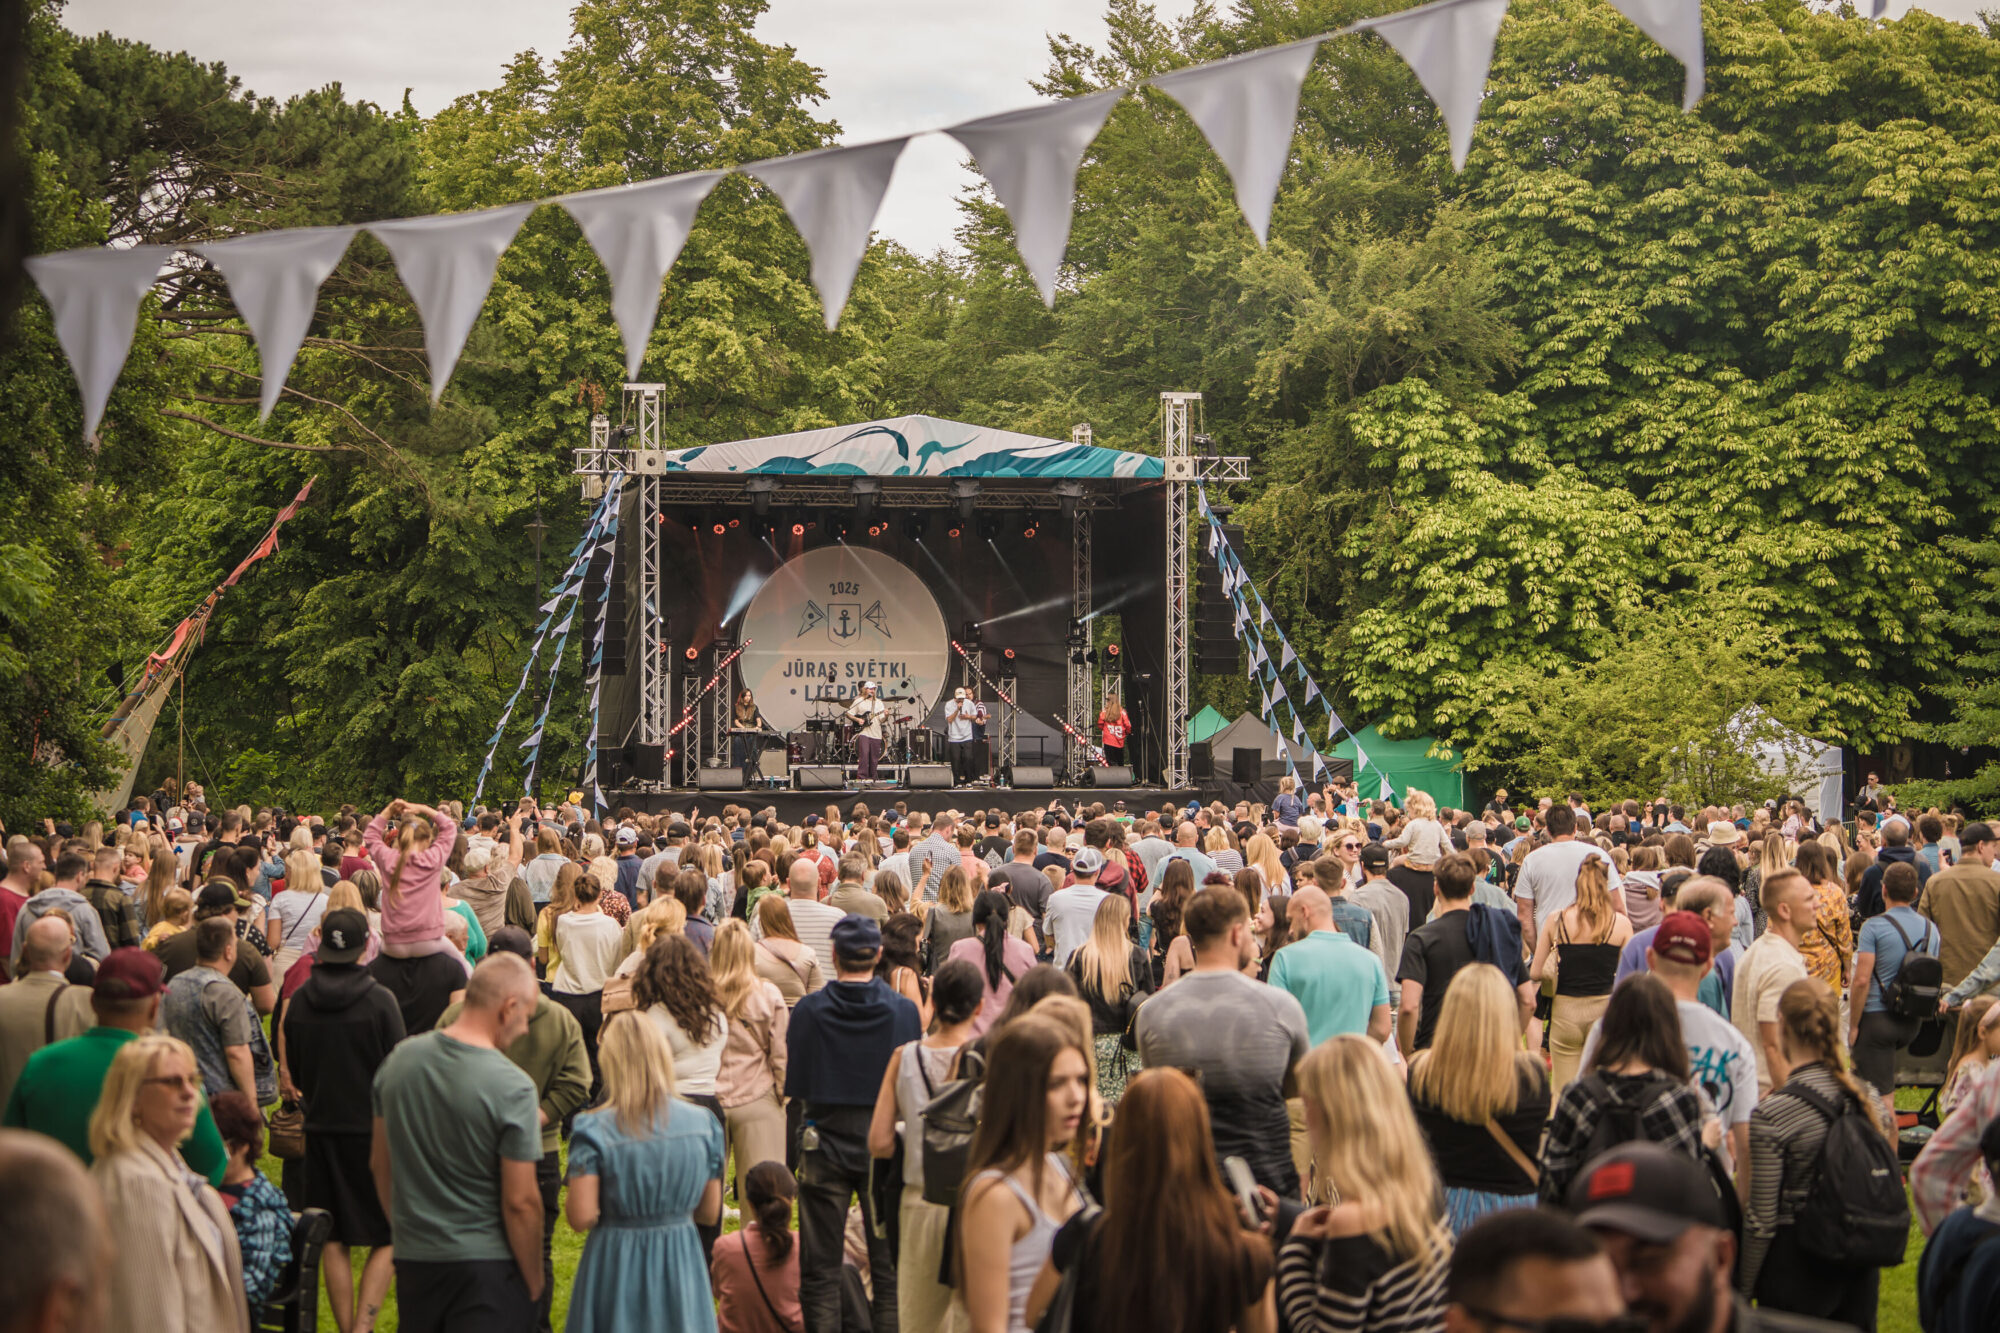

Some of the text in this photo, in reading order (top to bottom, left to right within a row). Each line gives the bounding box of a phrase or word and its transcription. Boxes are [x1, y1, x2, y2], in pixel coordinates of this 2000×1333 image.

[829, 581, 860, 596] 2025
[783, 658, 906, 678] JŪRAS SVĒTKI
[804, 681, 885, 702] LIEPĀĀ
